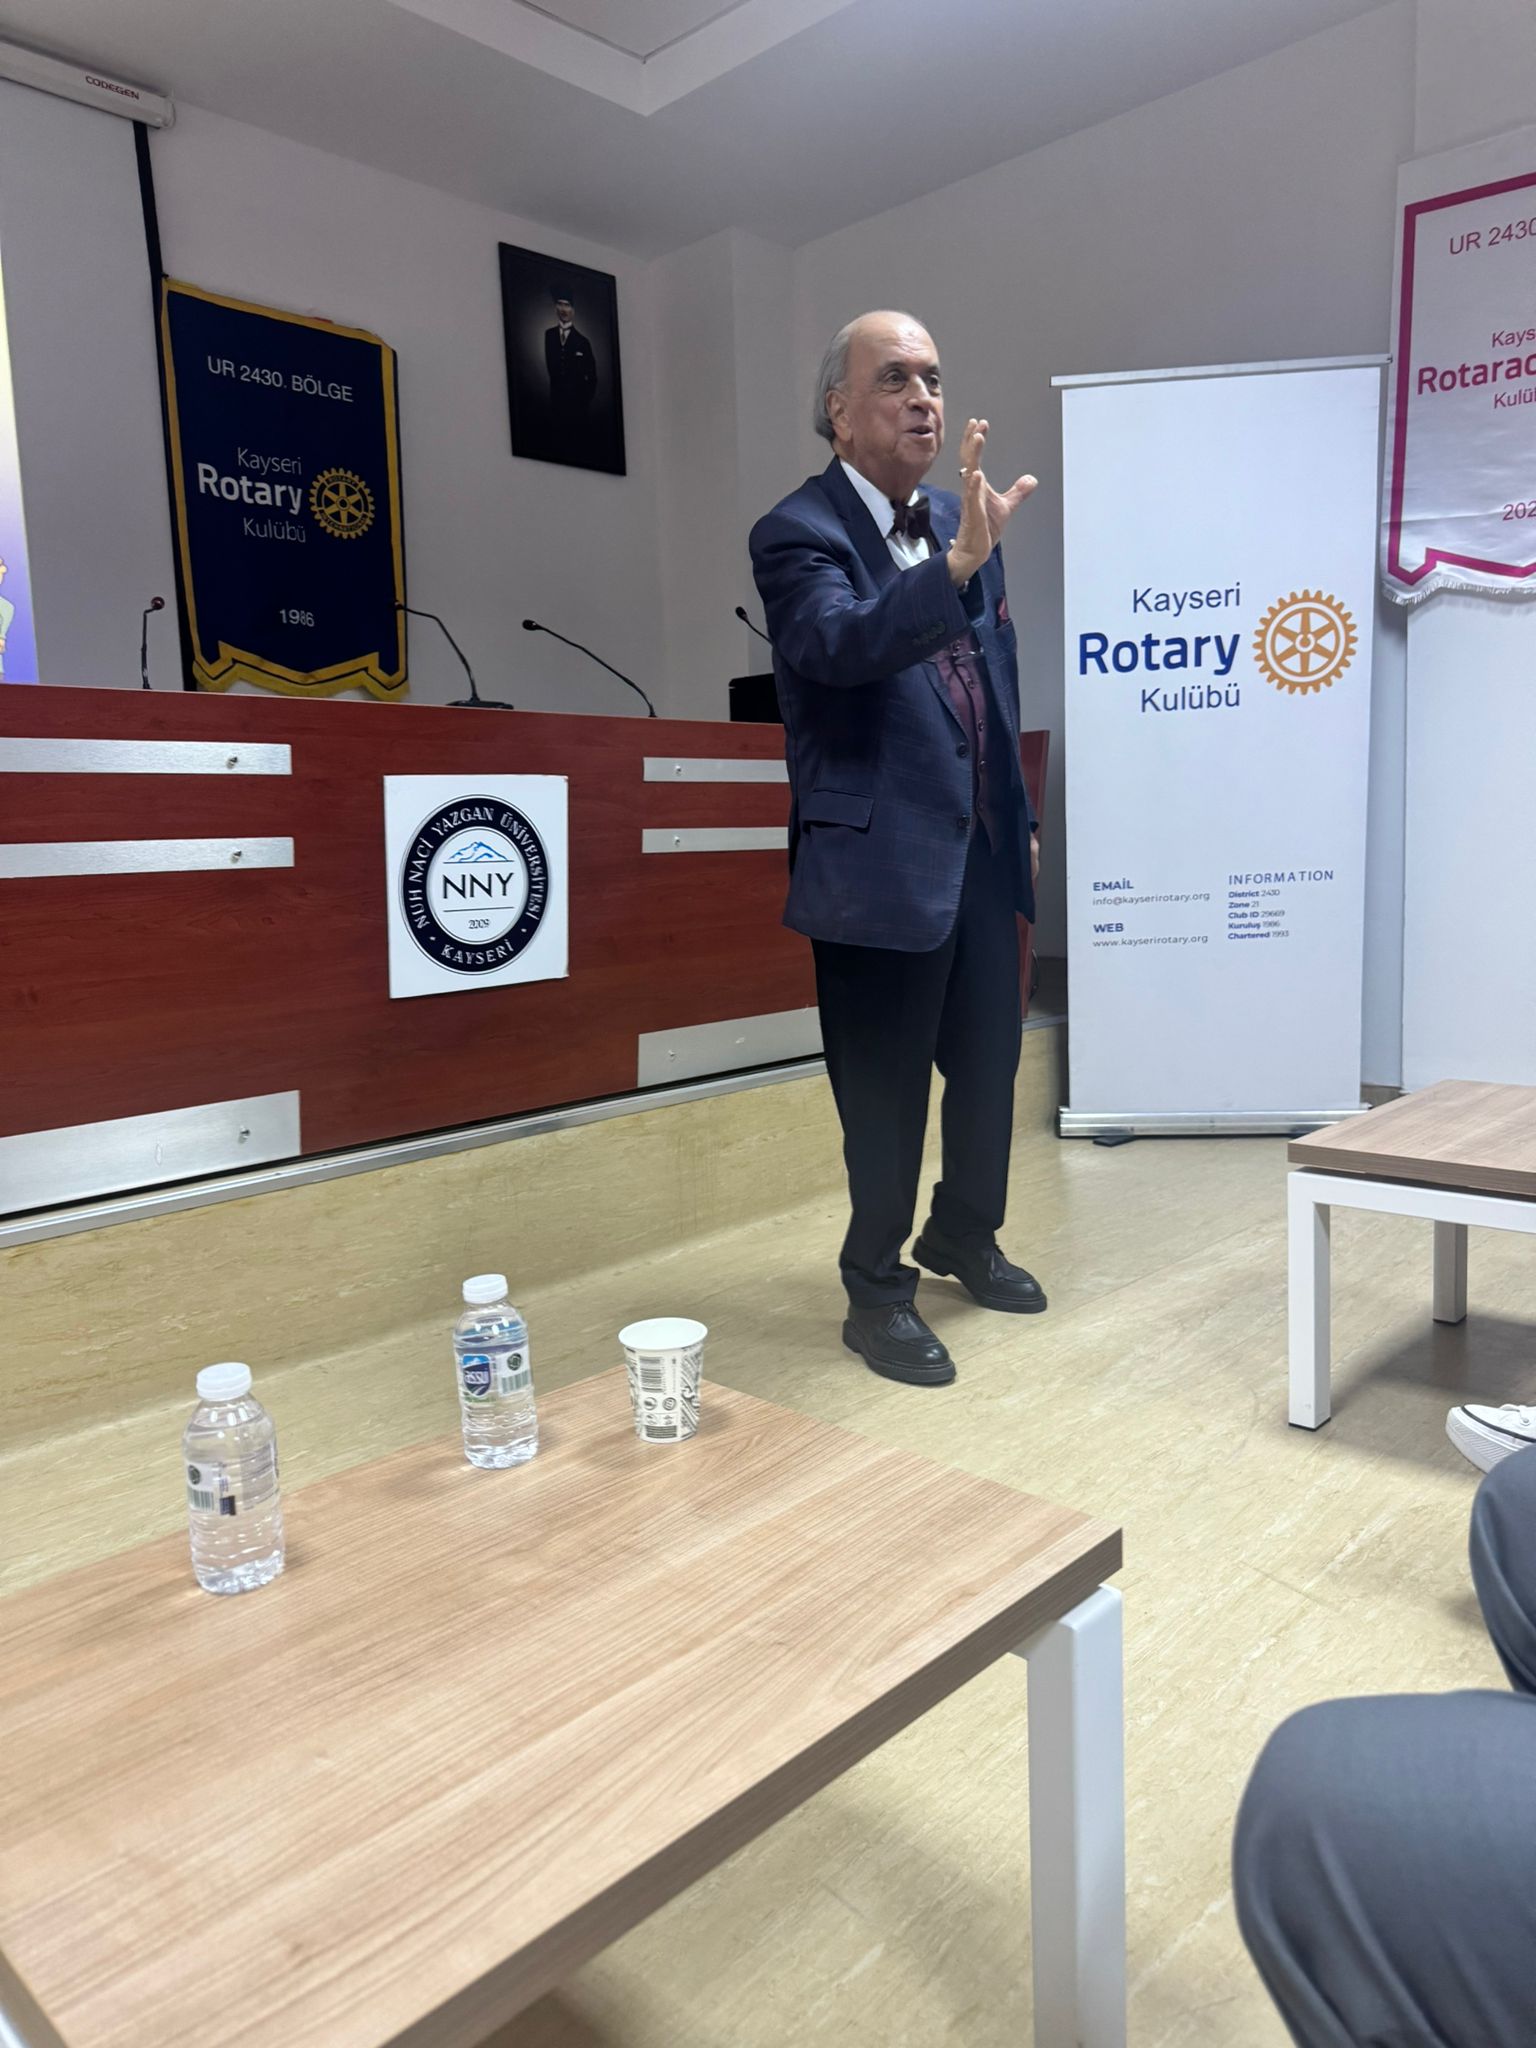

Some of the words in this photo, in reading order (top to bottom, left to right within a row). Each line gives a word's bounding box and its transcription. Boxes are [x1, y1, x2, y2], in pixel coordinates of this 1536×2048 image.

[85, 75, 140, 100] CODEGEN
[1449, 231, 1481, 255] UR
[1491, 328, 1536, 348] Kays
[207, 355, 236, 378] UR
[240, 365, 287, 389] 2430.
[291, 374, 354, 403] BÖLGE
[1494, 387, 1536, 409] Kulü
[237, 447, 302, 476] Kayseri
[197, 462, 302, 515] Rotary
[243, 517, 306, 543] Kulübü
[1132, 582, 1240, 617] Kayseri
[1079, 632, 1240, 676] Rotary
[1141, 683, 1240, 712] Kulübü
[408, 888, 431, 929] NUH
[431, 807, 495, 836] YAZGAN
[1228, 870, 1334, 885] INFORMATION
[442, 872, 515, 899] NNY
[1092, 878, 1134, 892] EMAİL
[1228, 890, 1260, 898] District
[1092, 892, 1211, 906] info@kayserirotary.org
[1228, 901, 1250, 909] Zone
[1228, 911, 1248, 919] Club
[1093, 922, 1124, 934] WEB
[1228, 931, 1270, 940] Chartered
[441, 939, 515, 965] KAYSERİ
[1092, 935, 1209, 948] www.kayserirotary.org
